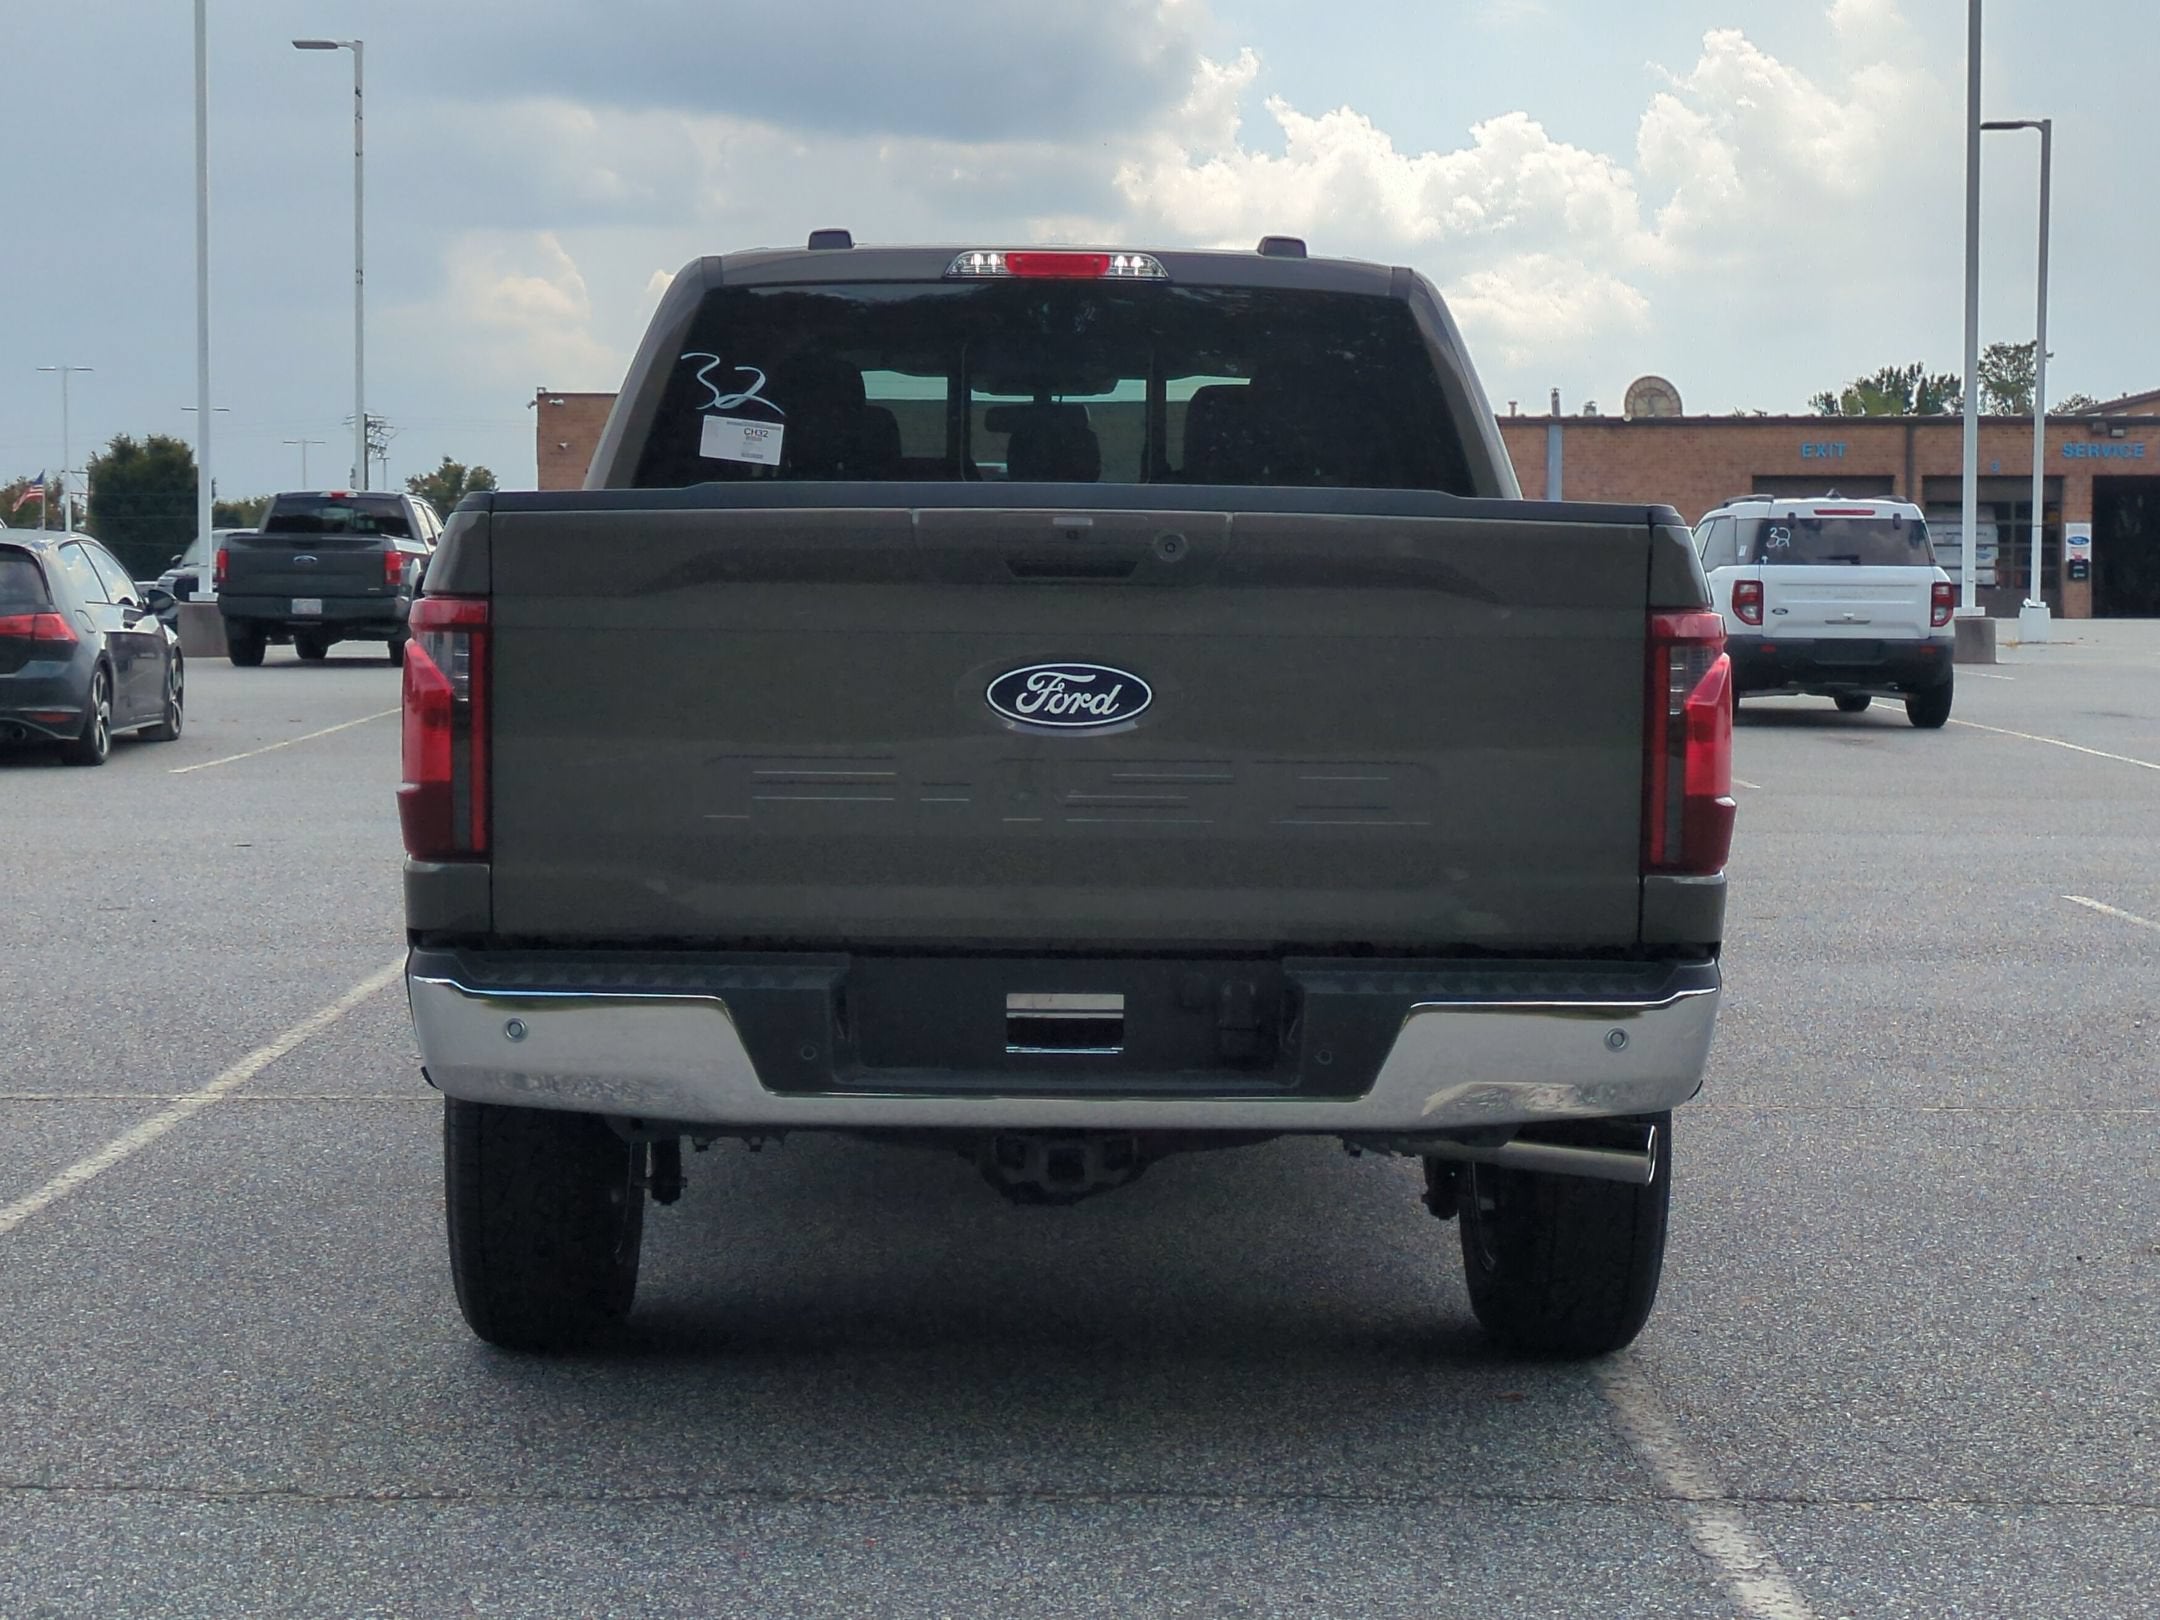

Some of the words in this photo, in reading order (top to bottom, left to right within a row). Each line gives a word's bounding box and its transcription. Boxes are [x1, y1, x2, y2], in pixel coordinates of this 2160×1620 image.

[681, 352, 786, 416] 32
[1801, 442, 1847, 458] EXIT
[2063, 441, 2145, 458] SERVICE
[1015, 671, 1123, 716] Ford
